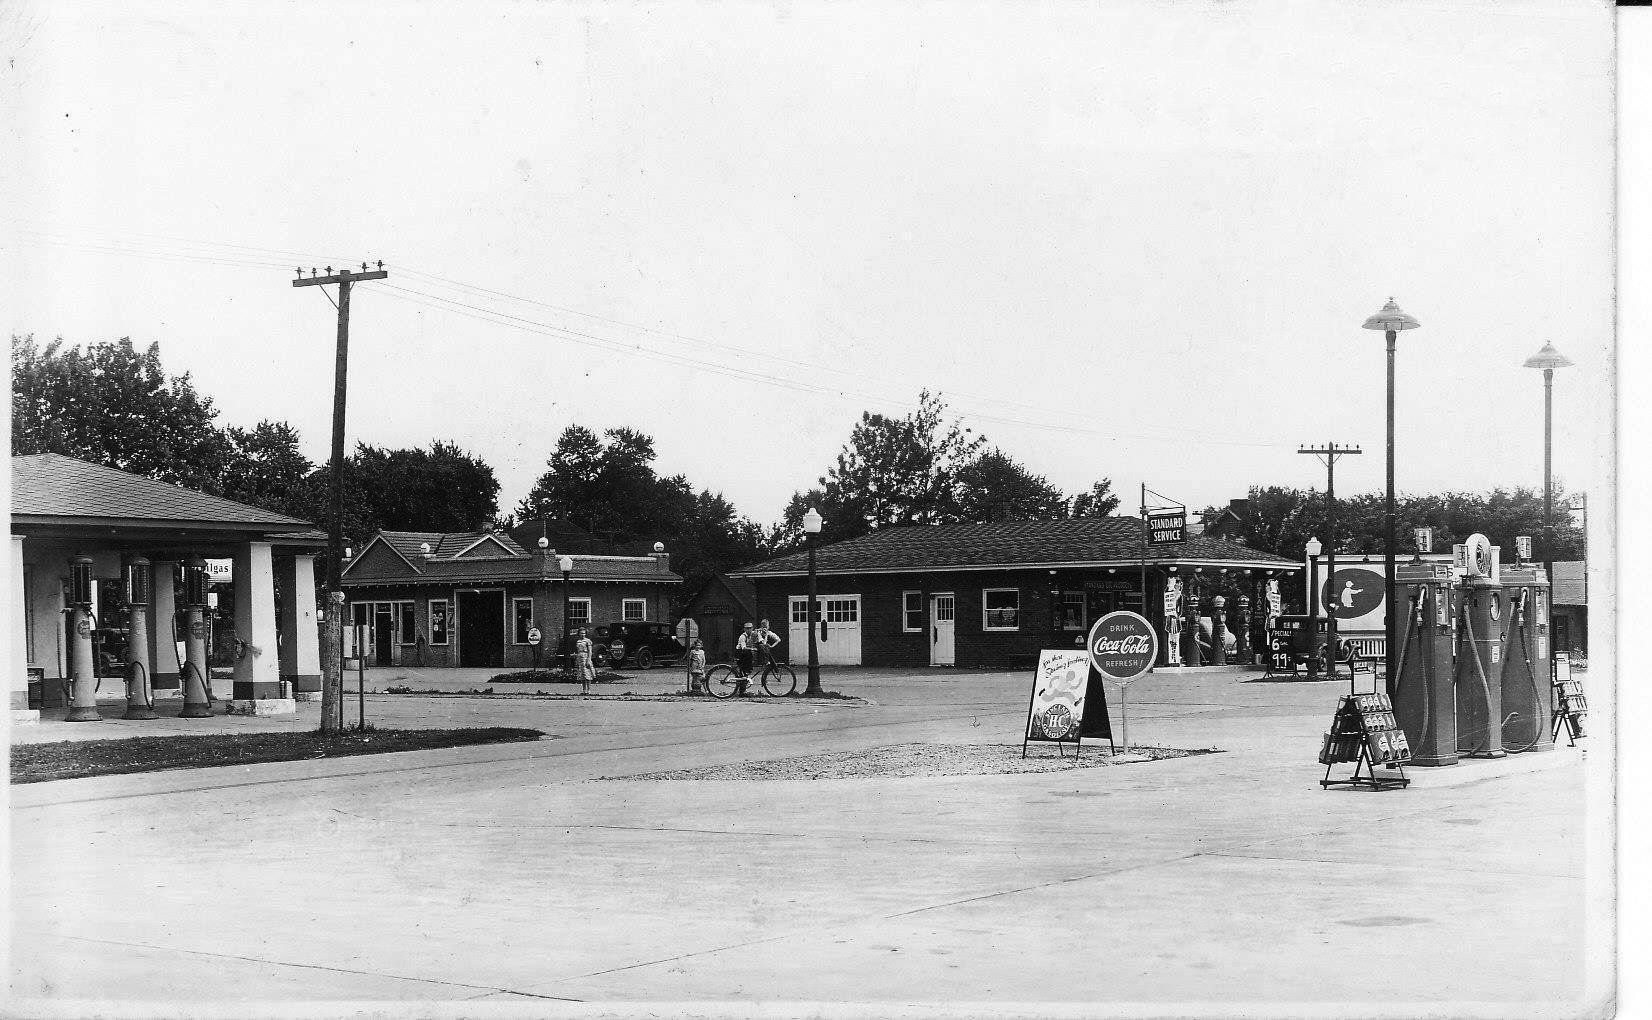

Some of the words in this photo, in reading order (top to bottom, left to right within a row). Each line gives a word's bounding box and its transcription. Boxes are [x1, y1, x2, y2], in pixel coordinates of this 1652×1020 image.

[1150, 517, 1183, 530] STANDARD
[1153, 530, 1181, 542] SERVICE
[1094, 635, 1151, 655] Coca-Cola
[1272, 638, 1280, 651] 6
[1105, 660, 1143, 669] REFRESH!
[1043, 723, 1070, 739] GASOLINE
